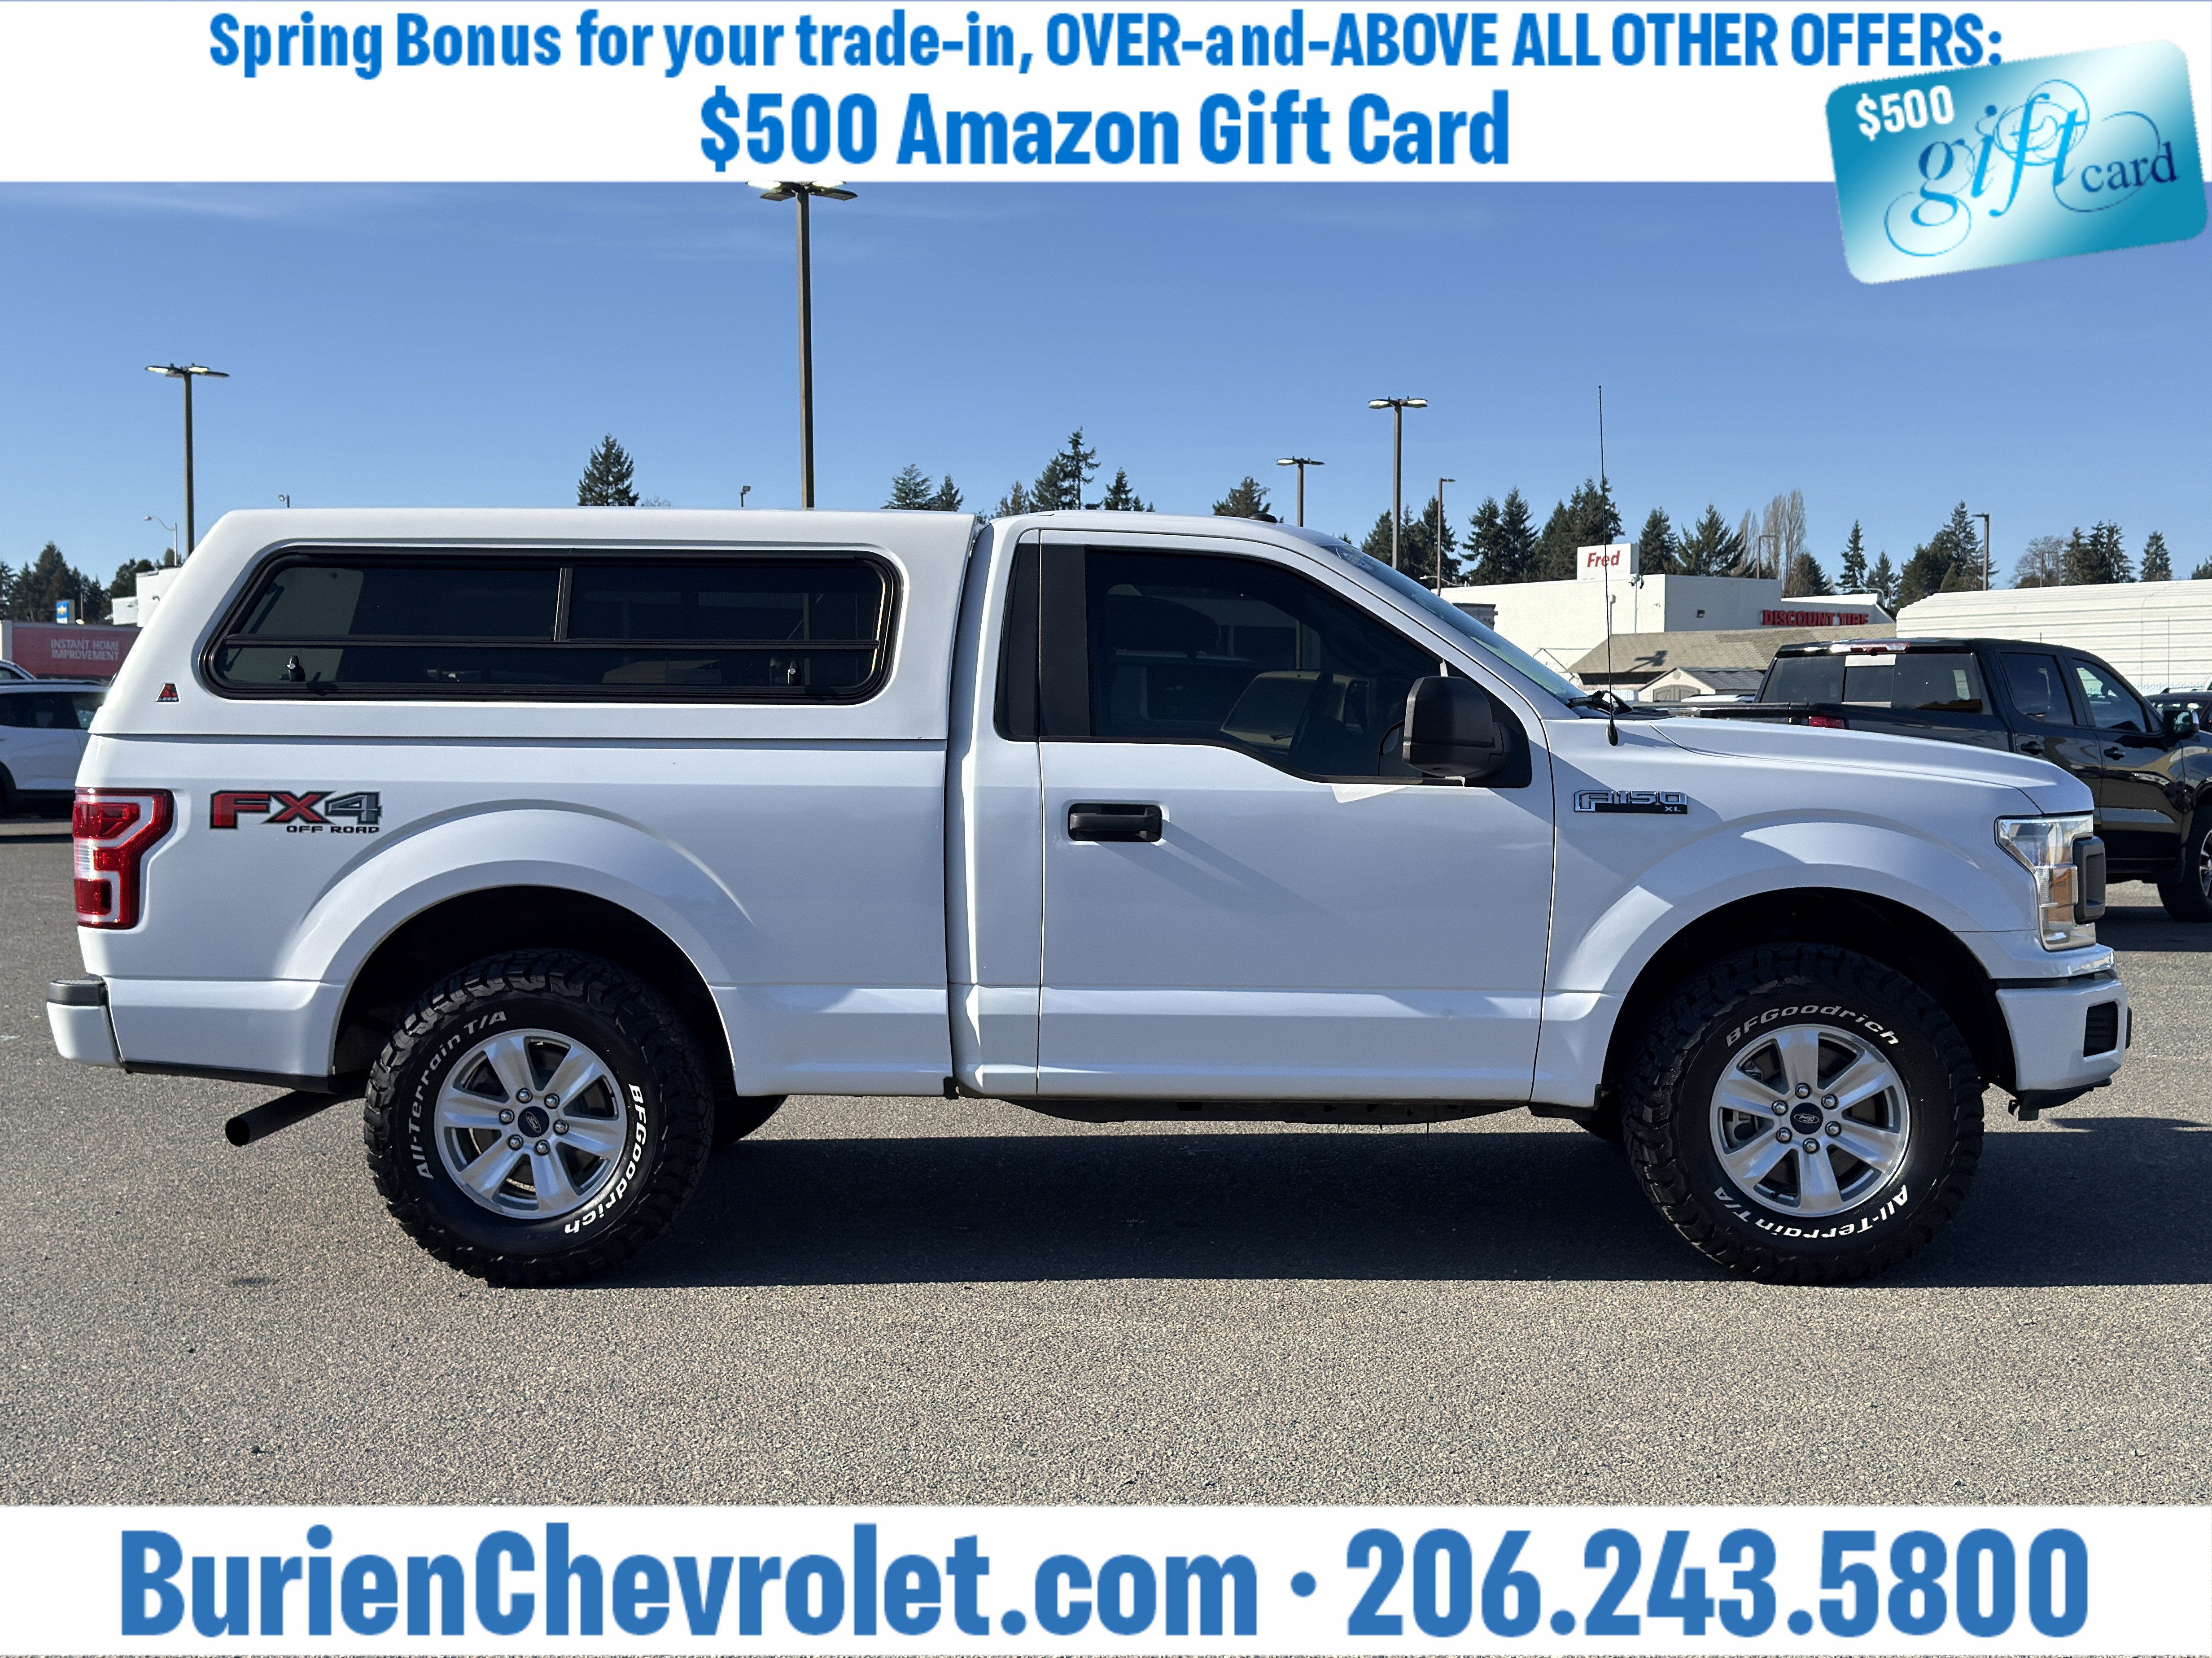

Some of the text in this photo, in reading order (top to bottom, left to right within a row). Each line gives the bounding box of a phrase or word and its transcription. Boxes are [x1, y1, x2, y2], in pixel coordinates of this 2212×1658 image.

[1587, 550, 1621, 567] Fred
[1762, 610, 1869, 627] DISCOUNT TIRE
[51, 638, 89, 649] INSTANT
[52, 649, 119, 661] IMPROVEMENT
[210, 790, 382, 829] FX4
[286, 825, 380, 833] OFF ROAD
[1726, 1005, 1899, 1047] BFGoodrich
[409, 1011, 507, 1179] All-Terrain T/A
[564, 1083, 646, 1233] BFGoodrich
[1714, 1184, 1908, 1238] All-Terrain T/A
